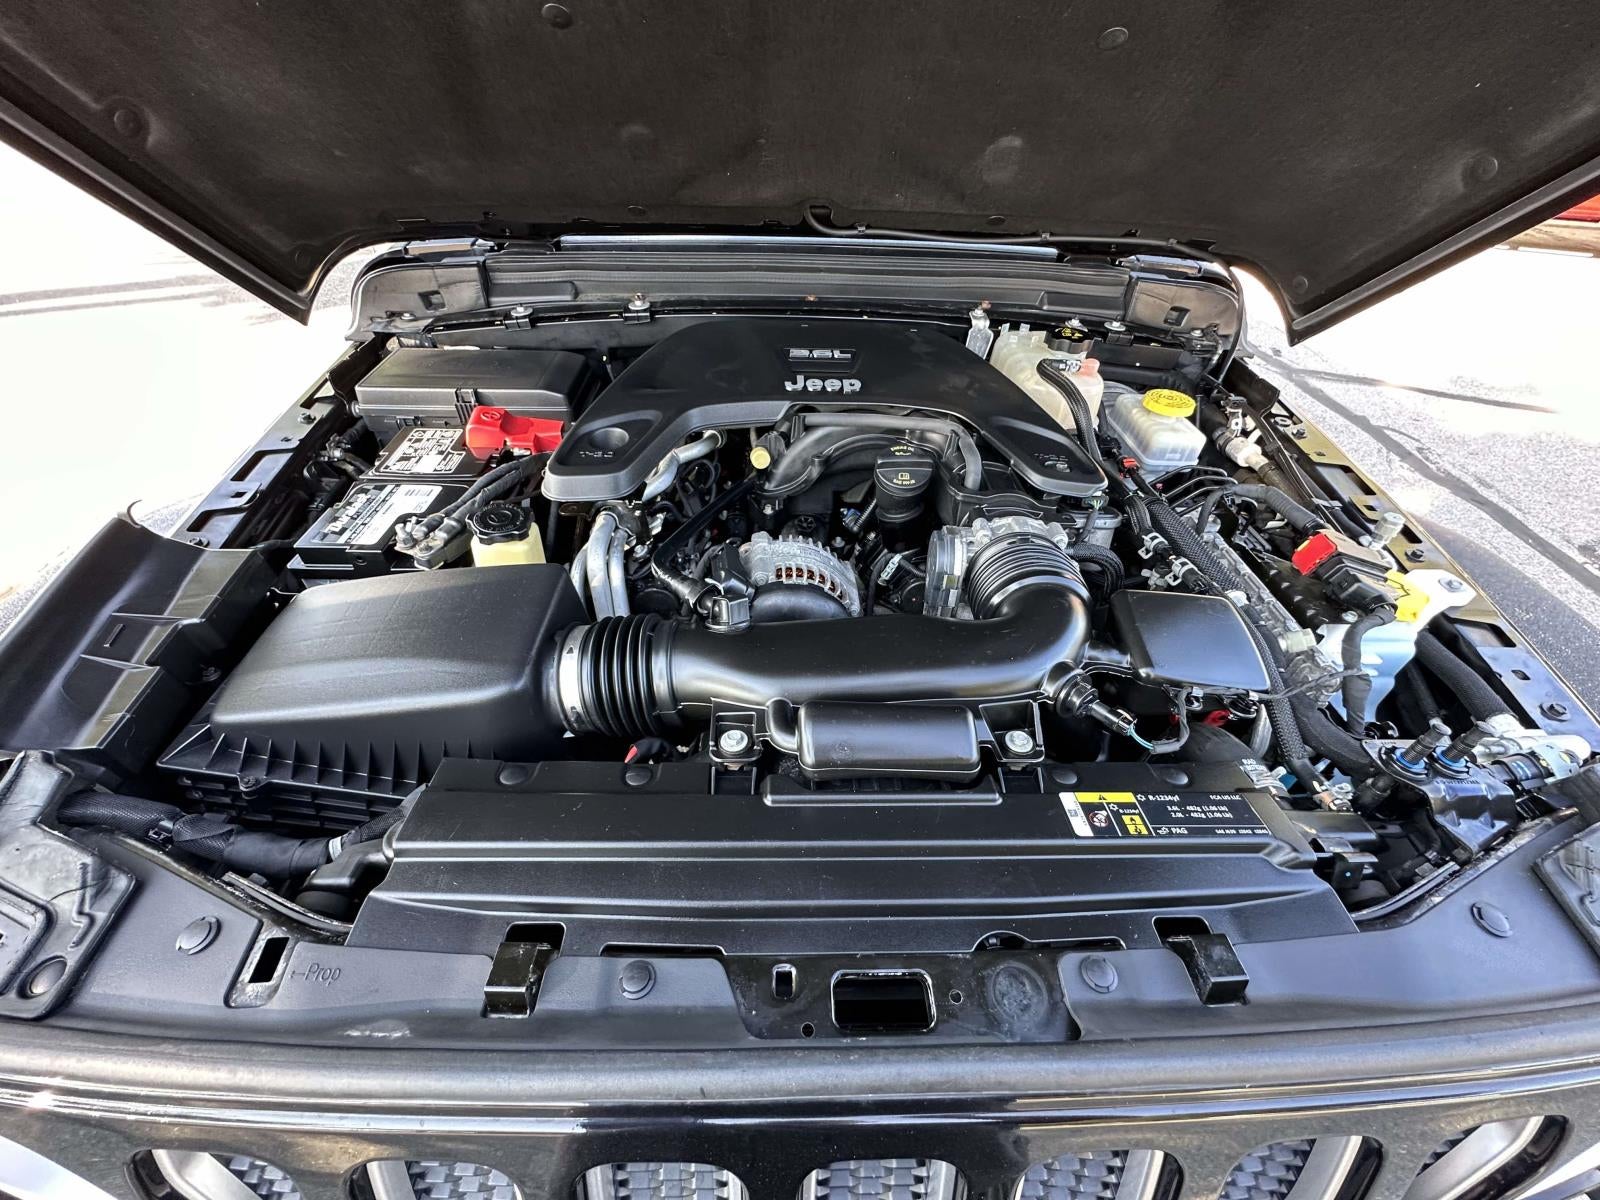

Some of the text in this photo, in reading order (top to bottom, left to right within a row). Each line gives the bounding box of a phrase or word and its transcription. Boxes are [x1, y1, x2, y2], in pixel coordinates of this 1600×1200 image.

[784, 374, 862, 395] Jeep
[320, 493, 372, 534] Duralast
[1147, 794, 1180, 802] R-1234yf
[304, 962, 342, 987] Prop
